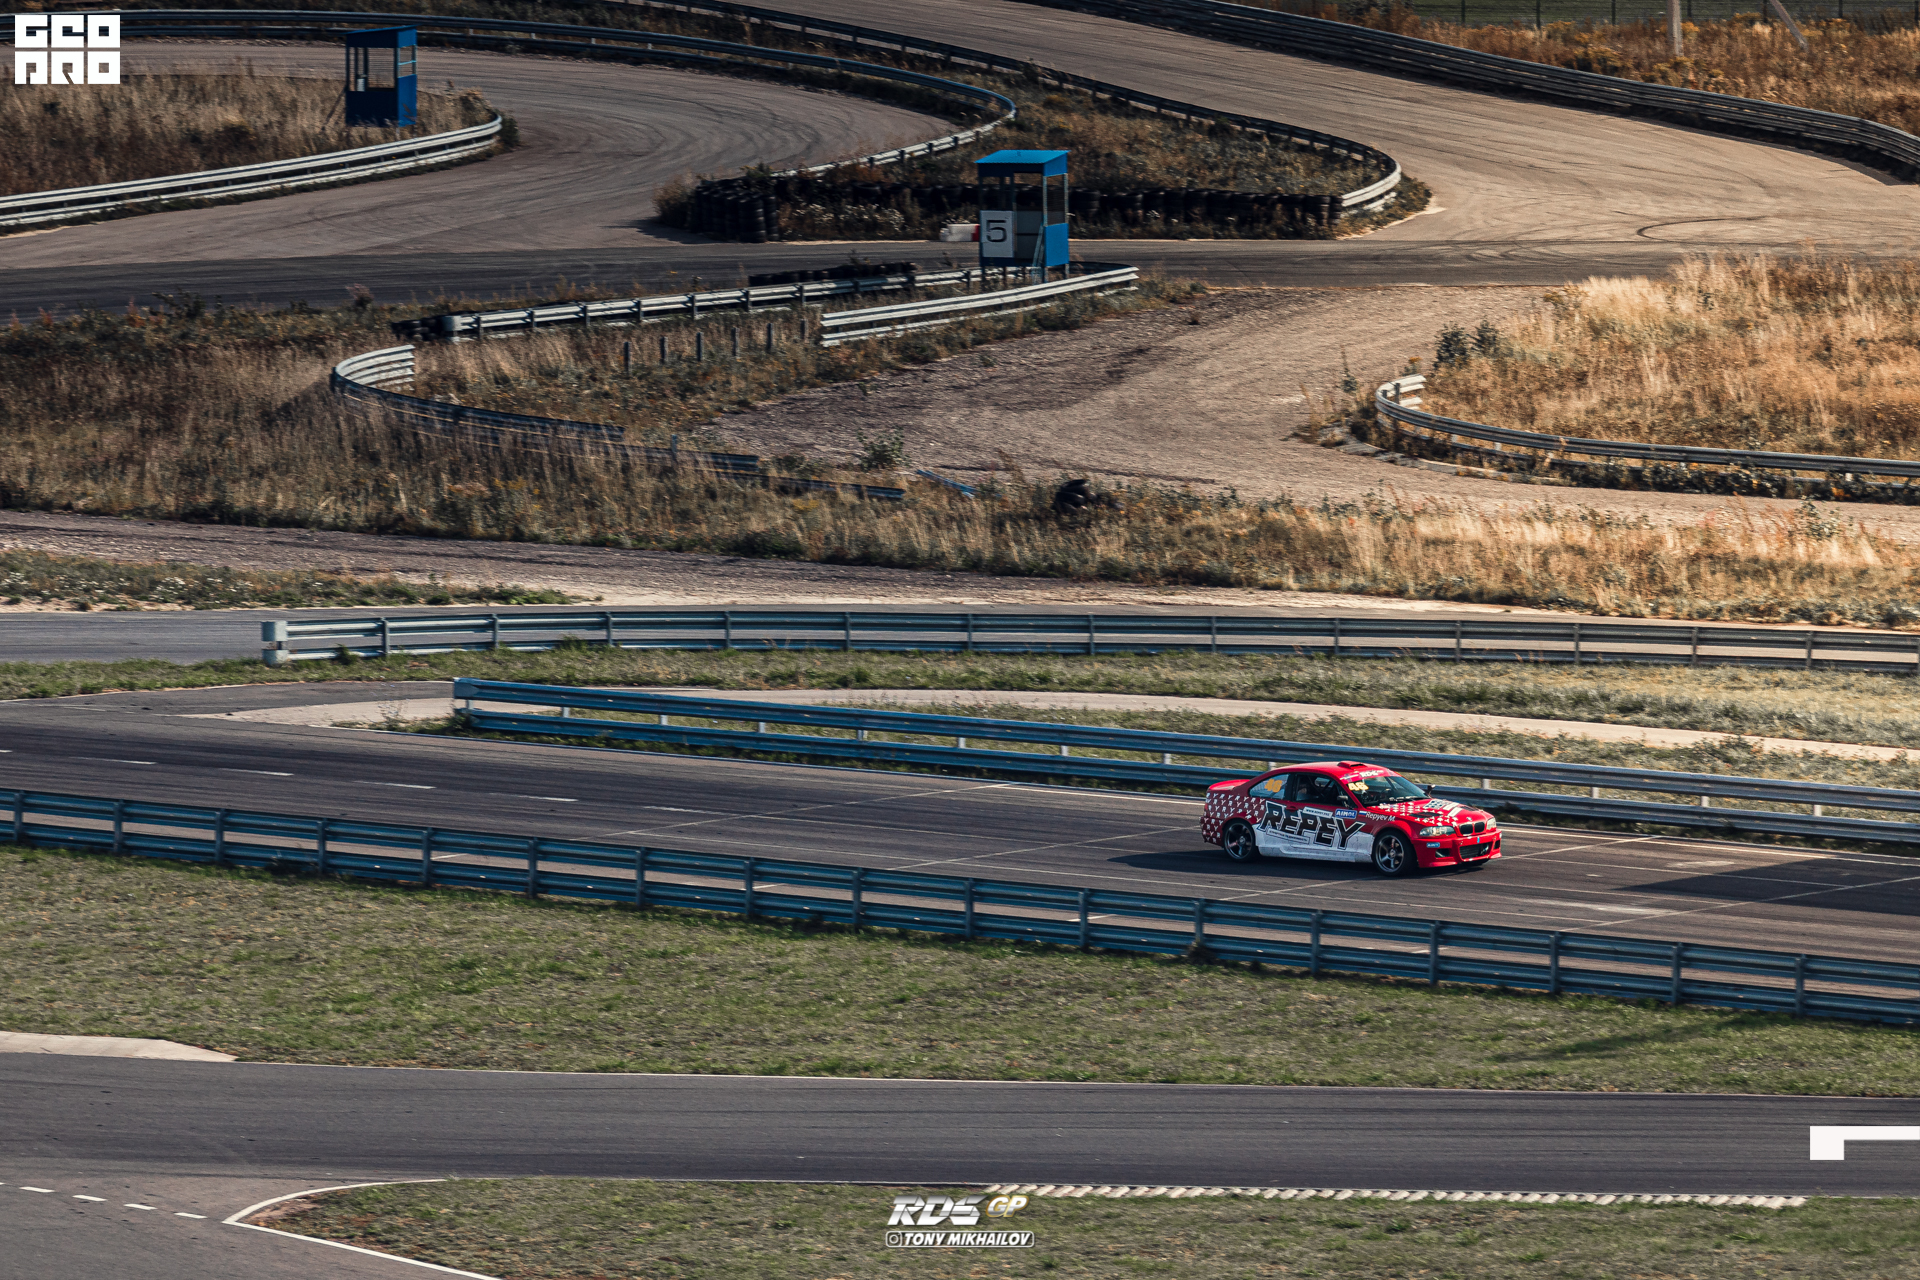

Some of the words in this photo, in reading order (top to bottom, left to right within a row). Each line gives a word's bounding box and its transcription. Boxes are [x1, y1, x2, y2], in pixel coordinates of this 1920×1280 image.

[986, 219, 1008, 243] 5
[1264, 778, 1283, 793] 46
[1257, 800, 1366, 850] REPEY
[1365, 811, 1387, 821] Repyev
